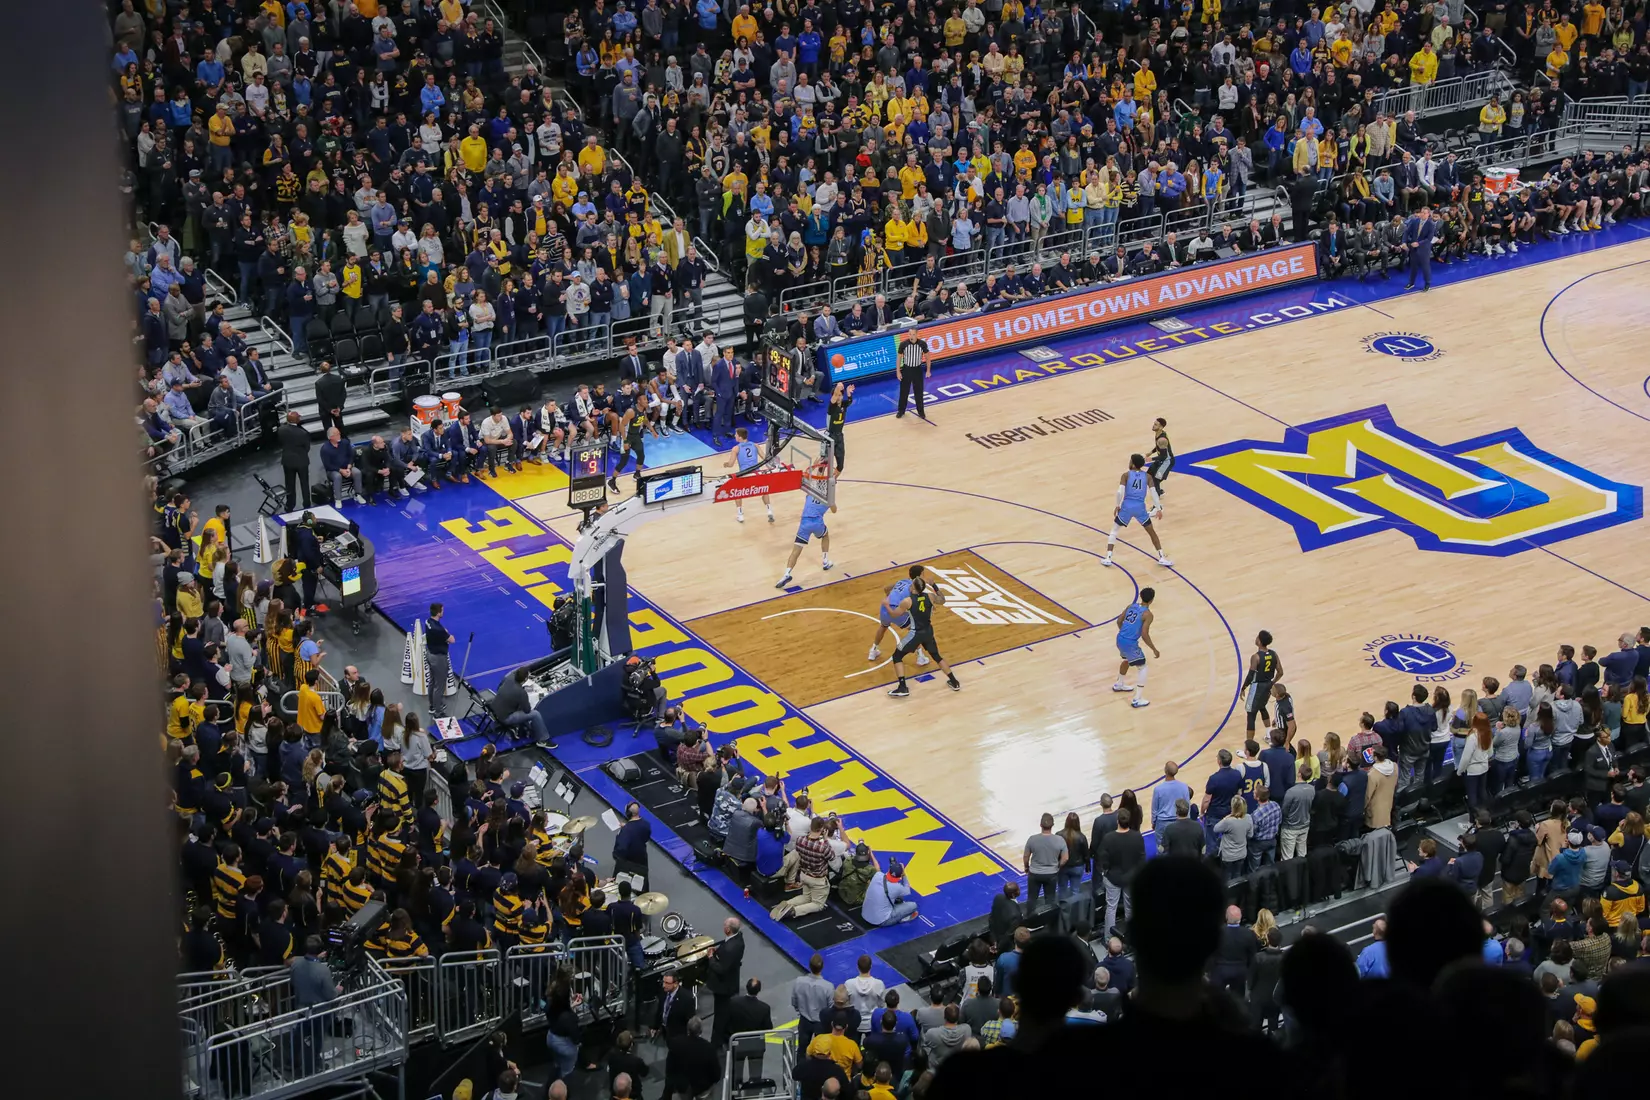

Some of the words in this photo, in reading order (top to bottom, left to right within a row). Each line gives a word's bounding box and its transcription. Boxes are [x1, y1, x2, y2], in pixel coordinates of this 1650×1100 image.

[921, 326, 985, 354] OUR
[993, 289, 1149, 339] HOMETOWN
[1158, 255, 1305, 302] ADVANTAGE
[846, 346, 888, 362] network
[1383, 339, 1430, 355] AL
[859, 356, 890, 368] health
[1401, 349, 1447, 362] COURT
[965, 408, 1115, 450] fiserv.forum
[745, 448, 752, 458] 2
[589, 460, 597, 474] 9
[1132, 478, 1142, 490] 41
[1189, 418, 1618, 546] MU
[894, 582, 904, 592] 24
[925, 565, 1049, 624] EAST
[919, 601, 926, 612] 4
[1125, 610, 1138, 624] 23
[1362, 633, 1456, 652] McGUIRE
[1264, 660, 1271, 672] 2
[1364, 654, 1385, 668] AL
[1392, 645, 1451, 672] AL
[402, 661, 412, 678] OUT
[1415, 661, 1473, 682] COURT
[1243, 778, 1263, 793] 30
